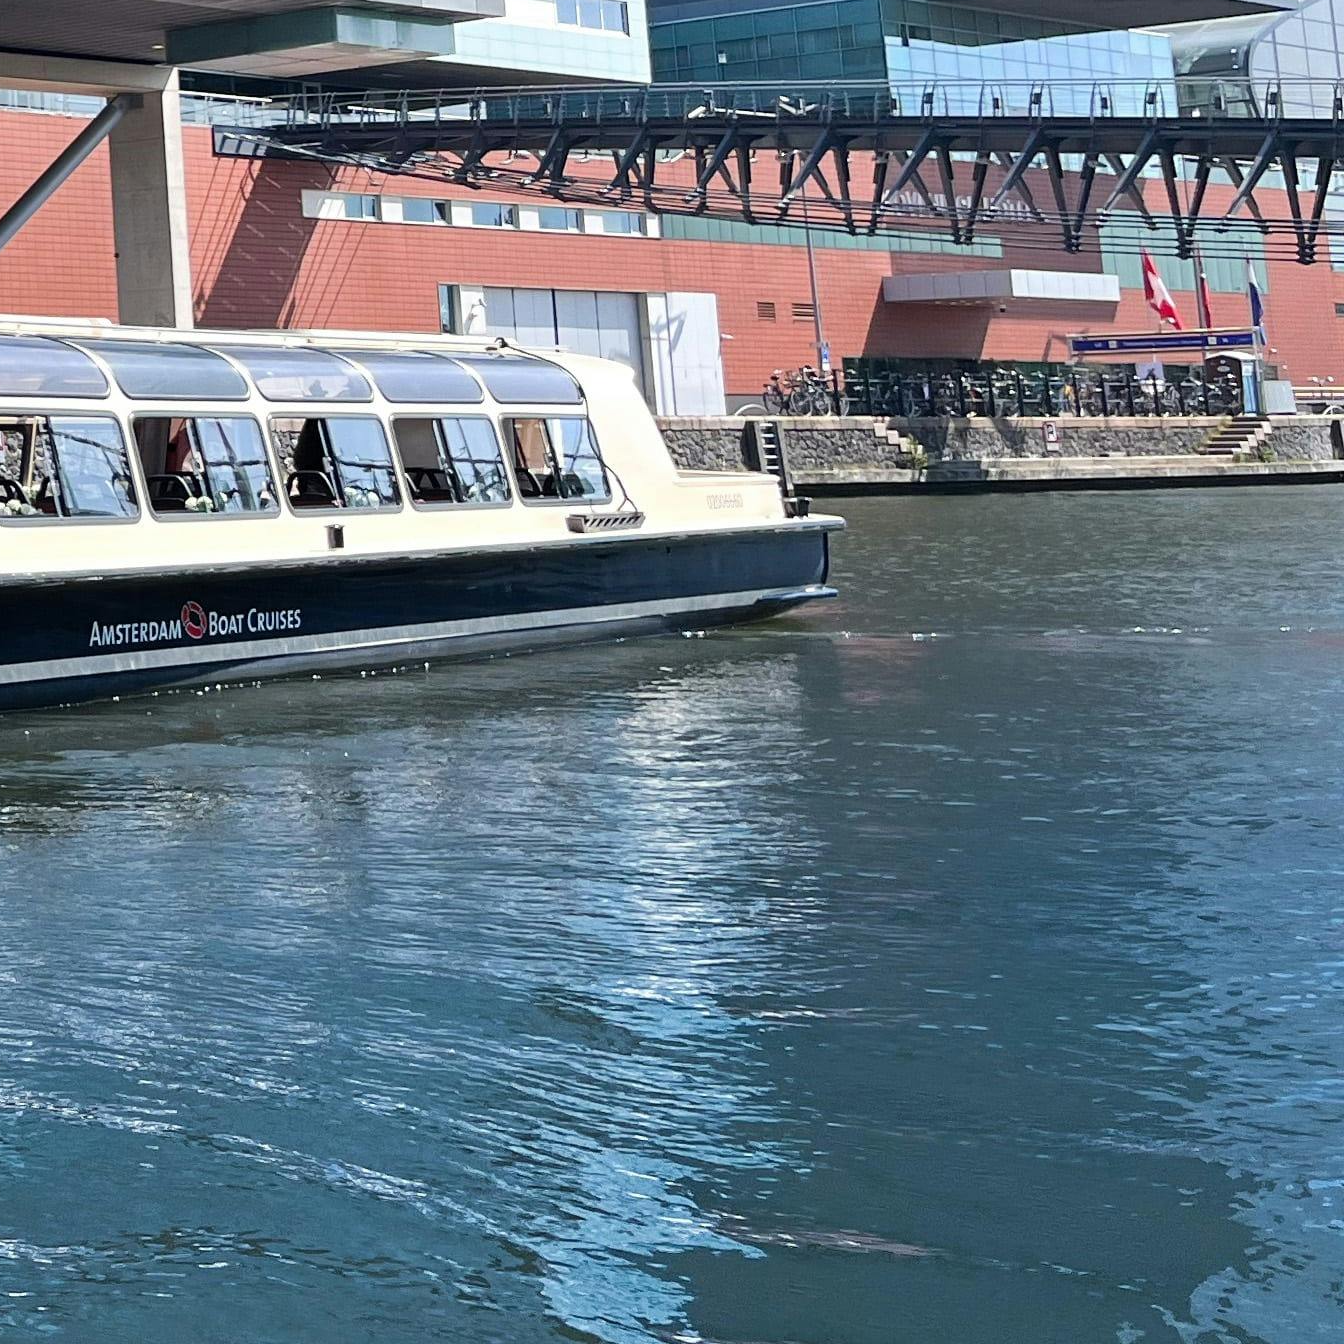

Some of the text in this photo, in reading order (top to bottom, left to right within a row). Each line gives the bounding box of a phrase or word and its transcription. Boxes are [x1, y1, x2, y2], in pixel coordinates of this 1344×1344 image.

[89, 608, 301, 647] AMSTERDAM BOAT CRUISES
